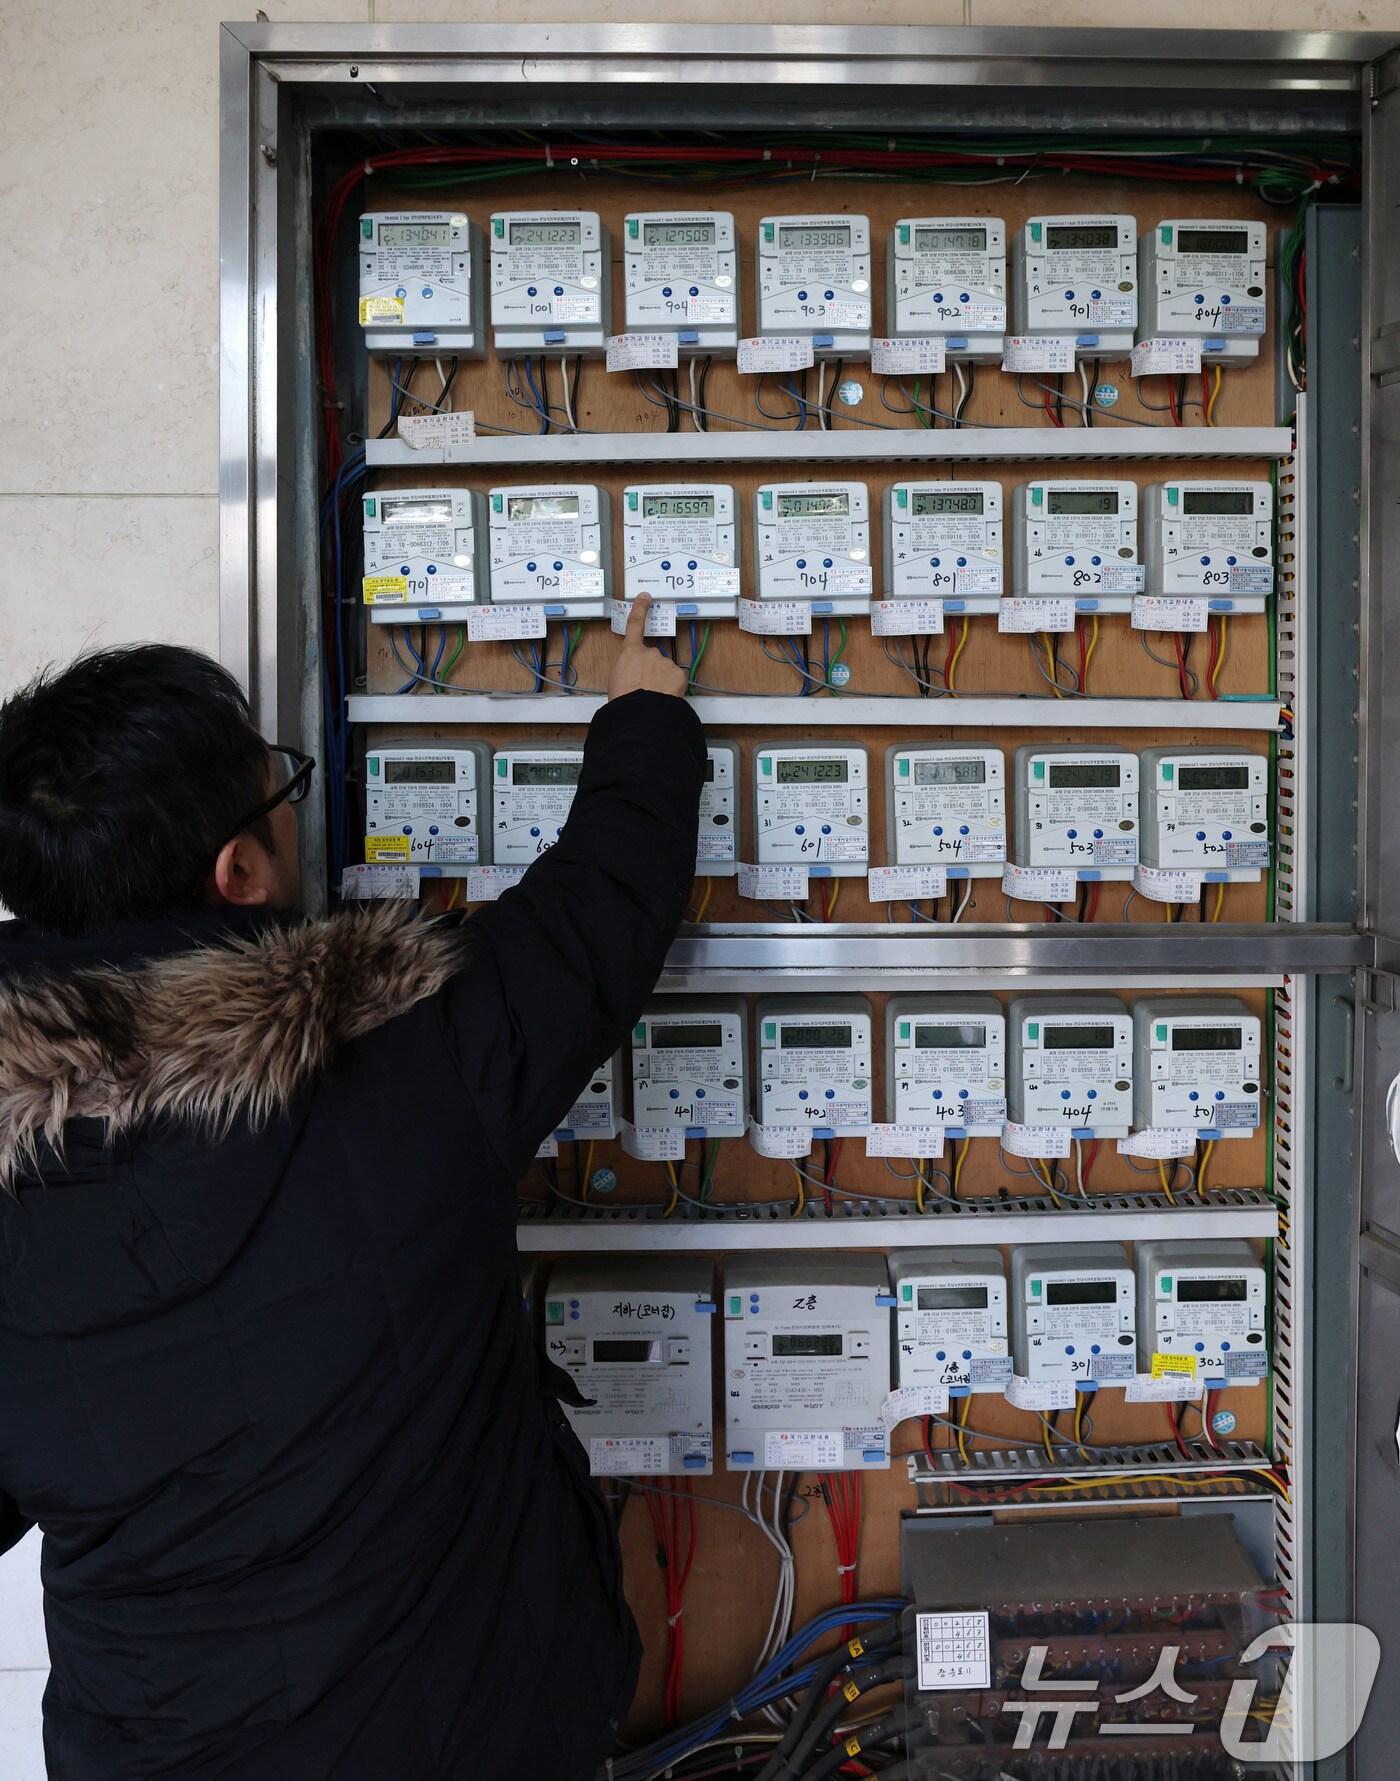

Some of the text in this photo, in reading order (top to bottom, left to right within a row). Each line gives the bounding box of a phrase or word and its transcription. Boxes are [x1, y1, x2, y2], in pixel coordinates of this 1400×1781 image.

[529, 302, 552, 315] 1001
[665, 300, 688, 317] 904
[800, 305, 826, 318] 903
[937, 307, 962, 321] 902
[1069, 303, 1091, 320] 901
[1194, 305, 1222, 329] 804
[408, 576, 429, 596] 701
[536, 575, 561, 591] 702
[665, 574, 695, 590] 703
[800, 572, 828, 591] 704
[932, 571, 956, 593] 801
[1073, 570, 1103, 586] 802
[1202, 570, 1230, 585] 803
[409, 837, 434, 860] 604
[800, 837, 821, 858] 601
[938, 839, 962, 858] 504
[1069, 842, 1094, 855] 503
[1202, 842, 1227, 854] 502
[674, 1103, 694, 1123] 401
[936, 1104, 965, 1121] 403
[1062, 1104, 1092, 1127] 404
[1192, 1105, 1216, 1124] 501
[1071, 1358, 1091, 1378] 301
[1197, 1357, 1225, 1368] 302
